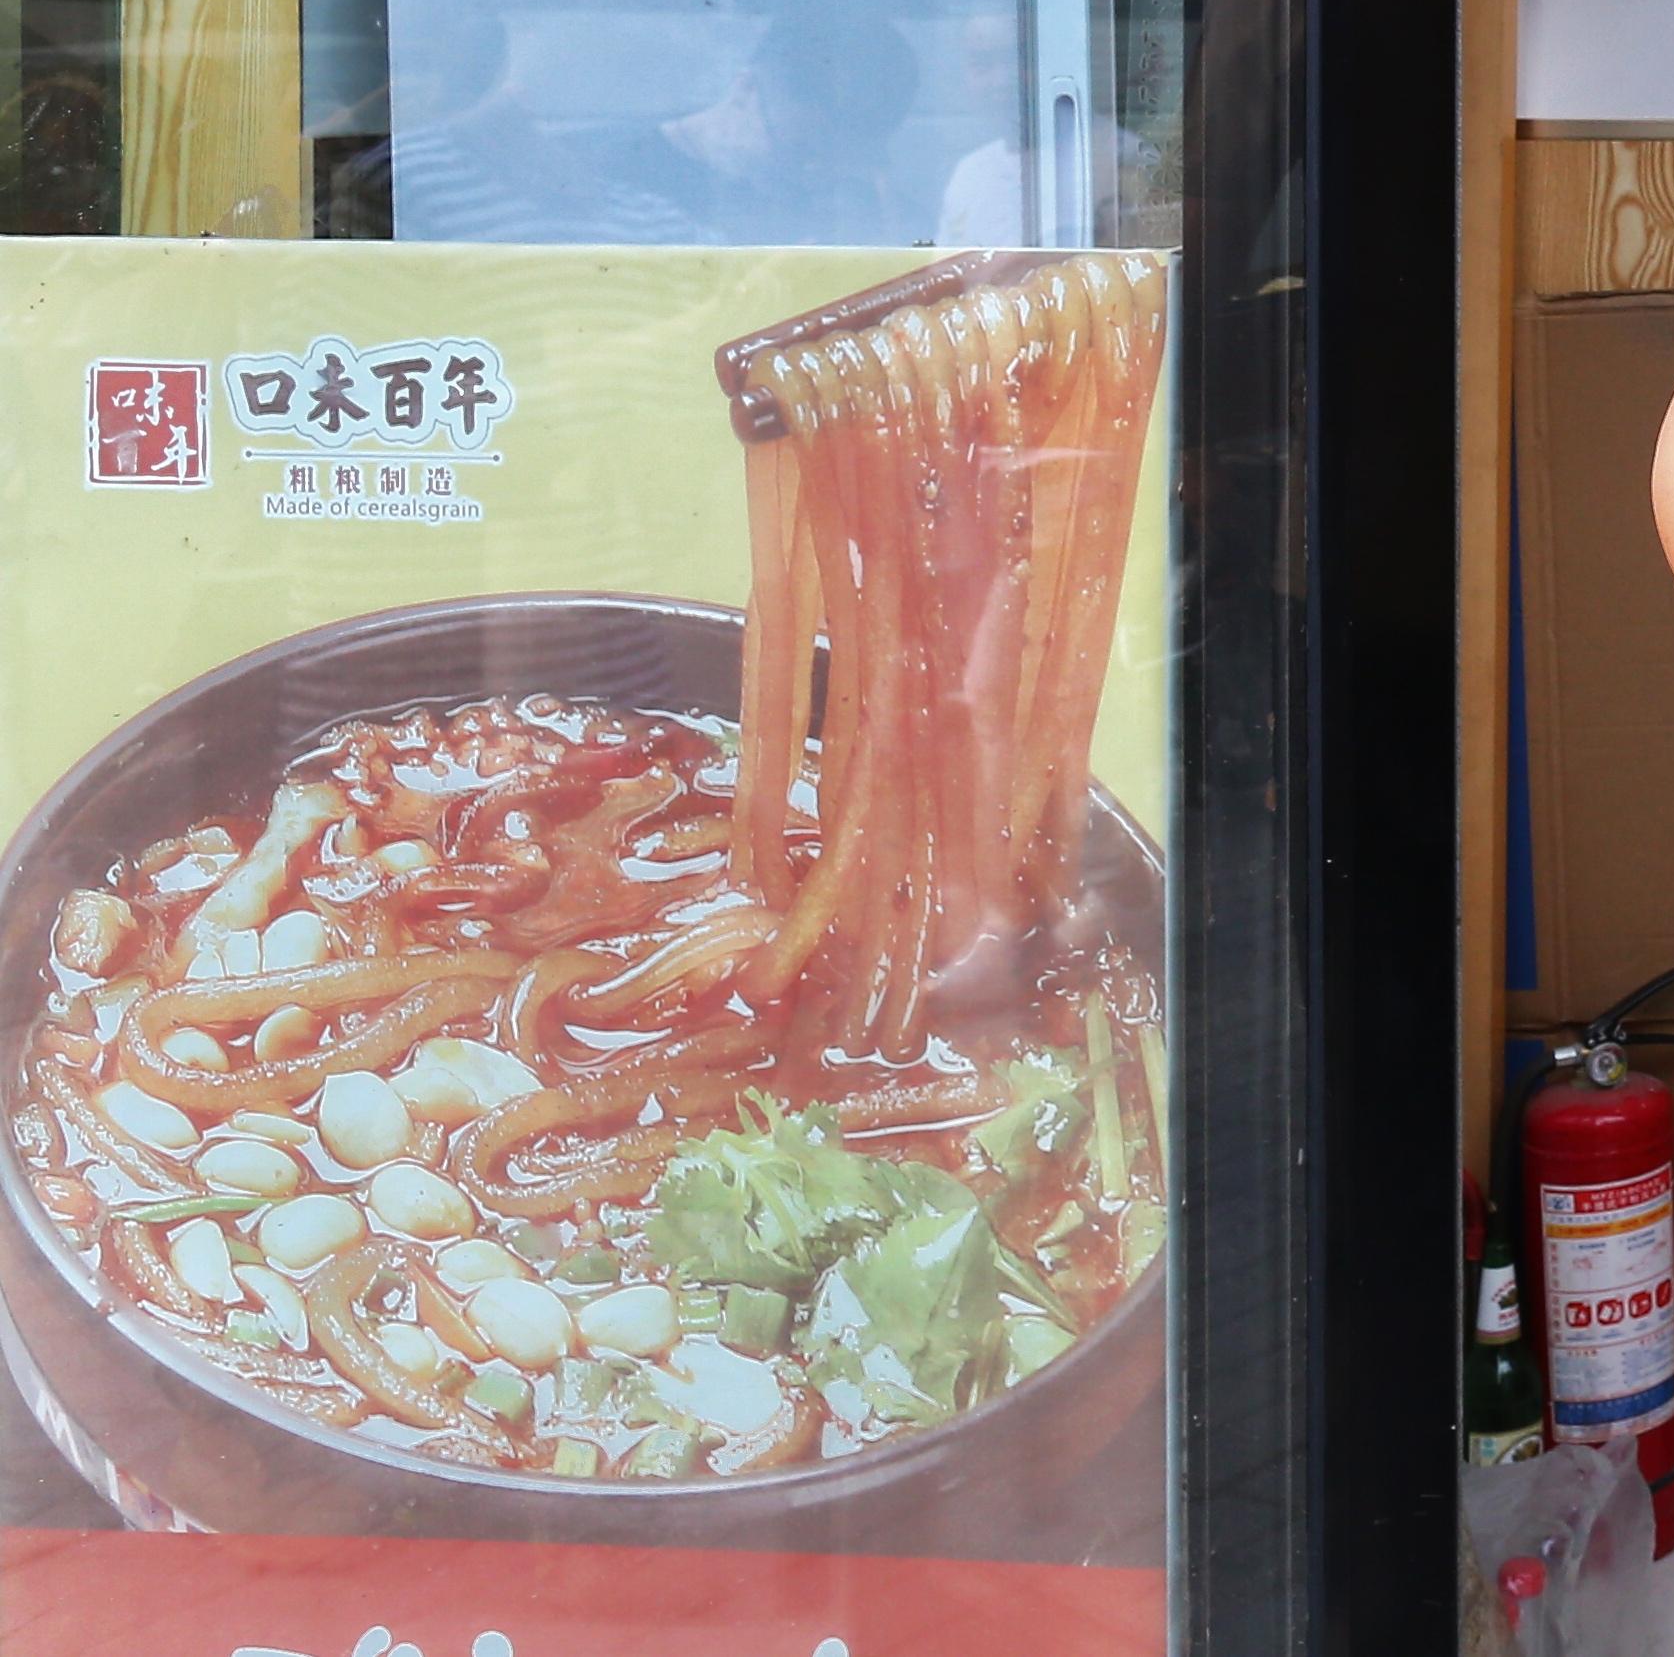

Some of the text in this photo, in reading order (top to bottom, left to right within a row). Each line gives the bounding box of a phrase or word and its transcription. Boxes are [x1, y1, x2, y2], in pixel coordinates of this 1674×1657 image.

[288, 464, 455, 496] 粗粮制造
[265, 496, 481, 523] Made of cerealsgrain
